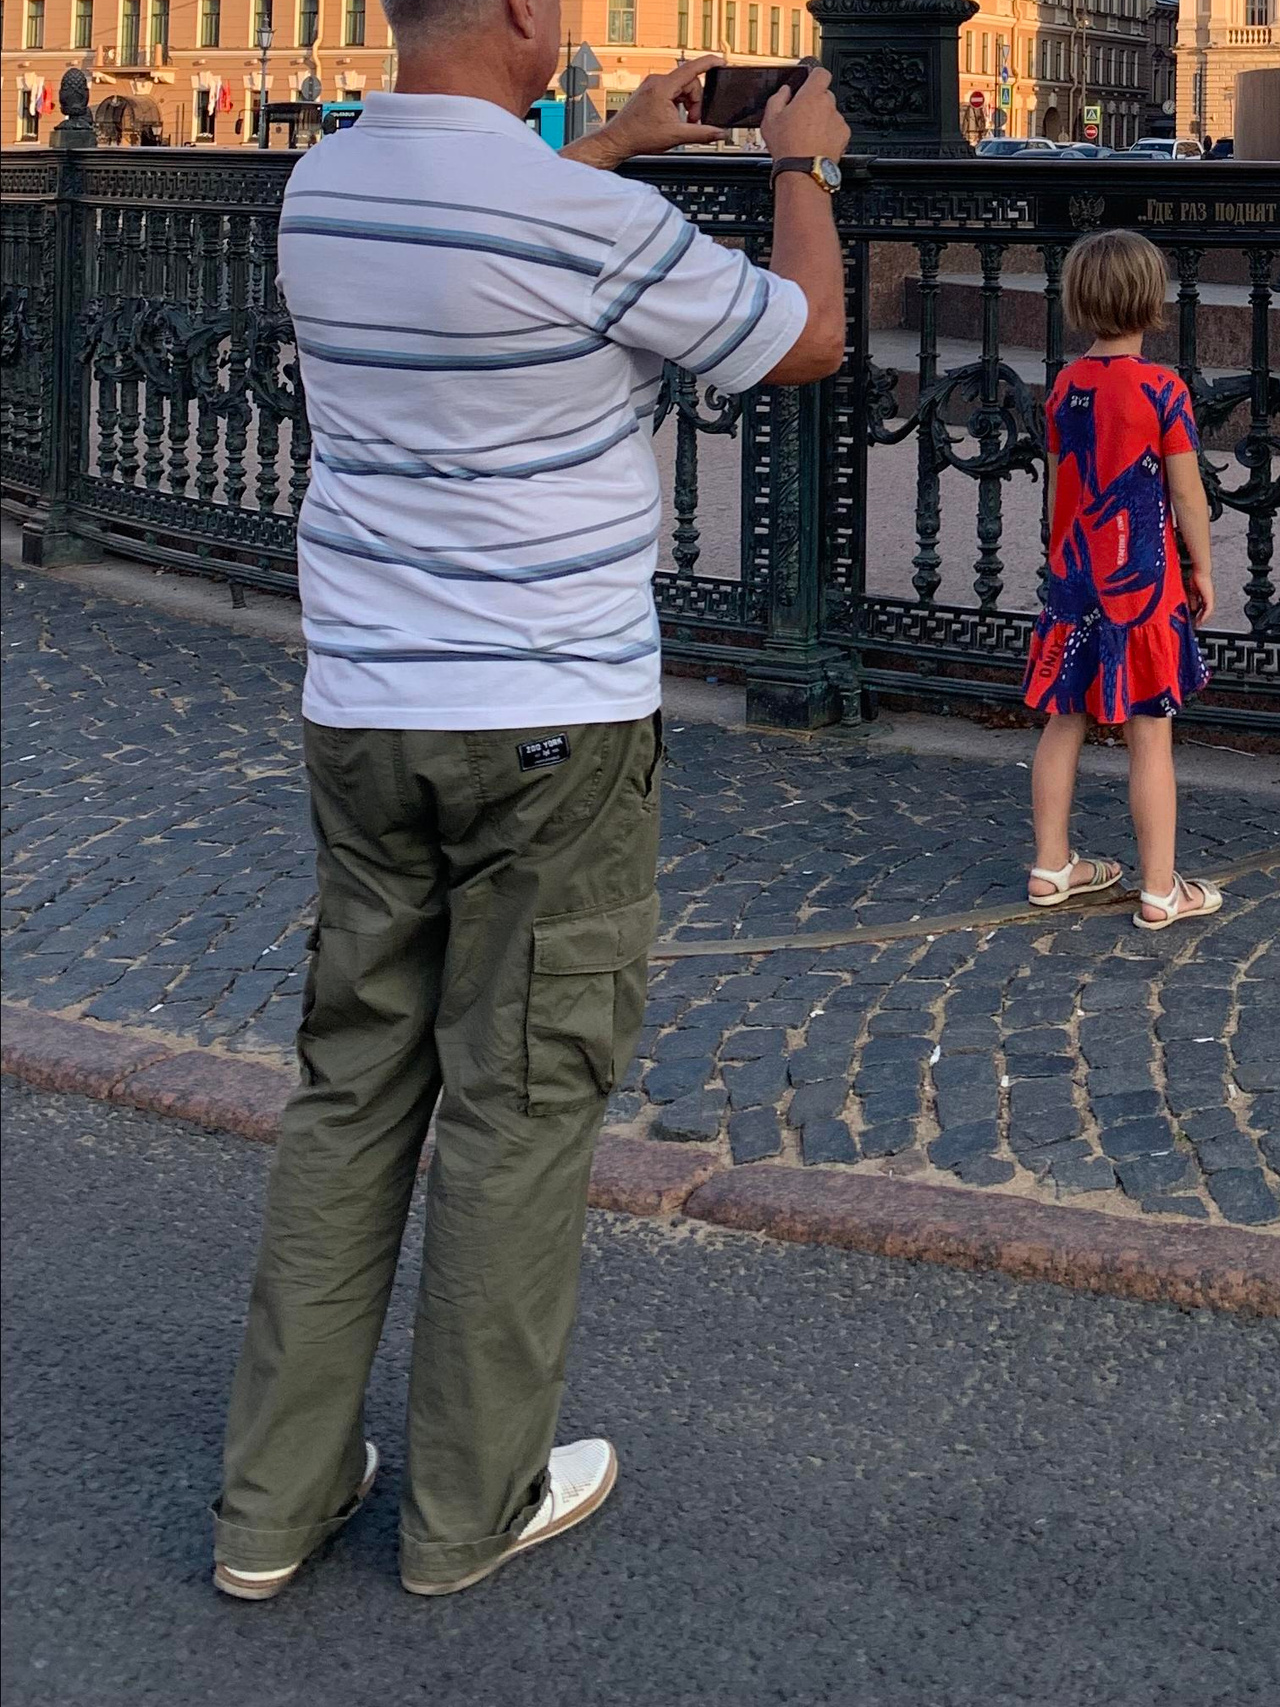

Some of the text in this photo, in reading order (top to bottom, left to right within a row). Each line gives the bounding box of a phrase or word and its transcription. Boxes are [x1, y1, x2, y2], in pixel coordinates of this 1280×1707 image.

[1180, 202, 1207, 222] РАЗ
[1215, 202, 1276, 225] ПОДНЯТ
[543, 737, 563, 749] YORK
